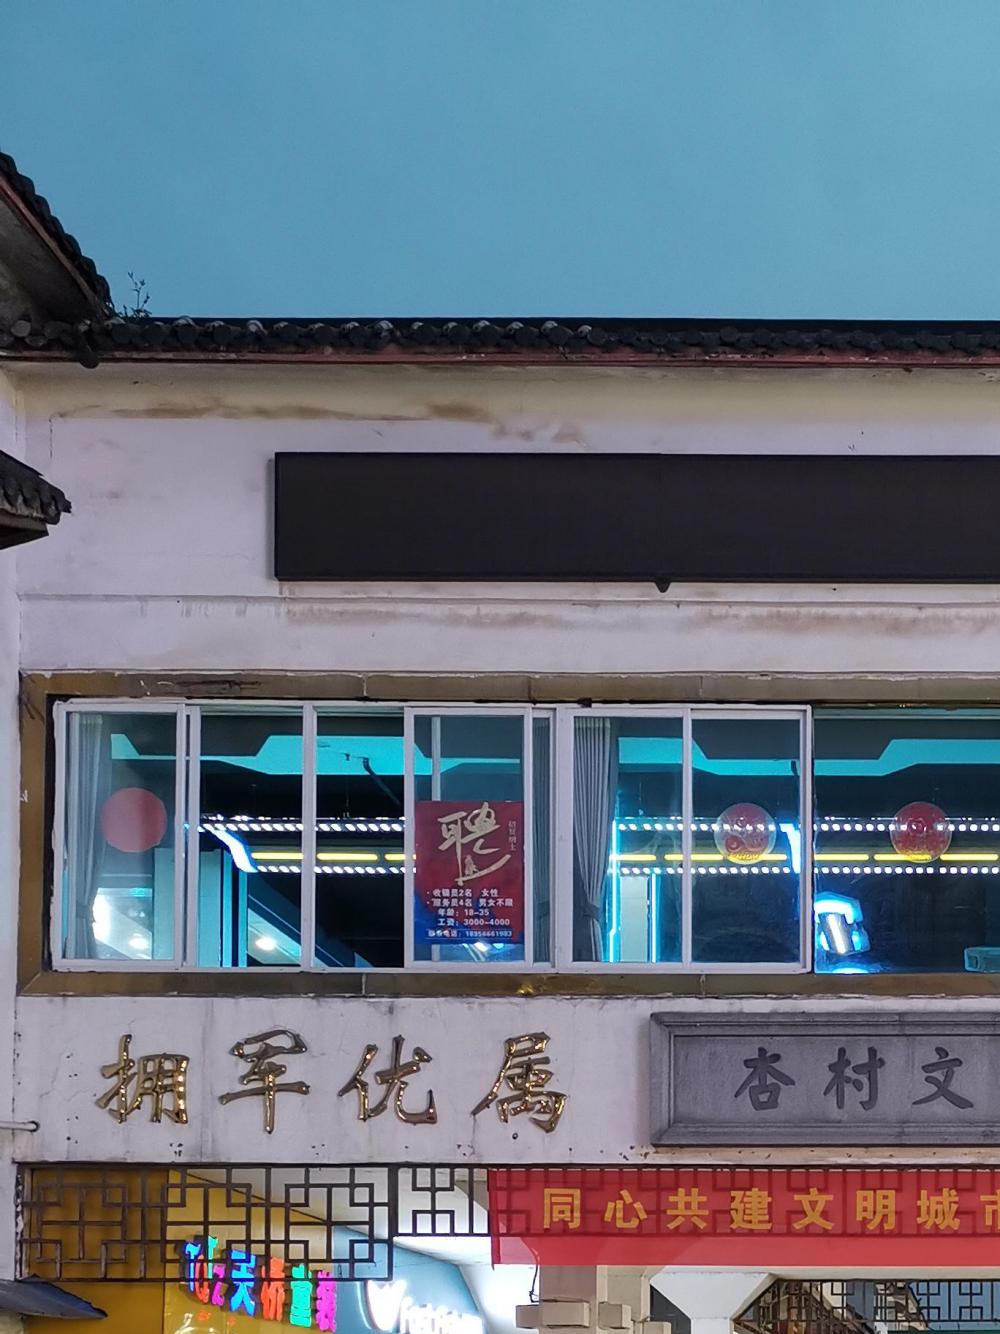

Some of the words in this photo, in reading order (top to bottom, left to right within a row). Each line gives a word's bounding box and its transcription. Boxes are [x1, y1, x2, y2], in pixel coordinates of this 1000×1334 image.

[437, 801, 511, 886] 聘
[481, 888, 499, 897] 女性
[96, 1029, 568, 1134] 拥军优属
